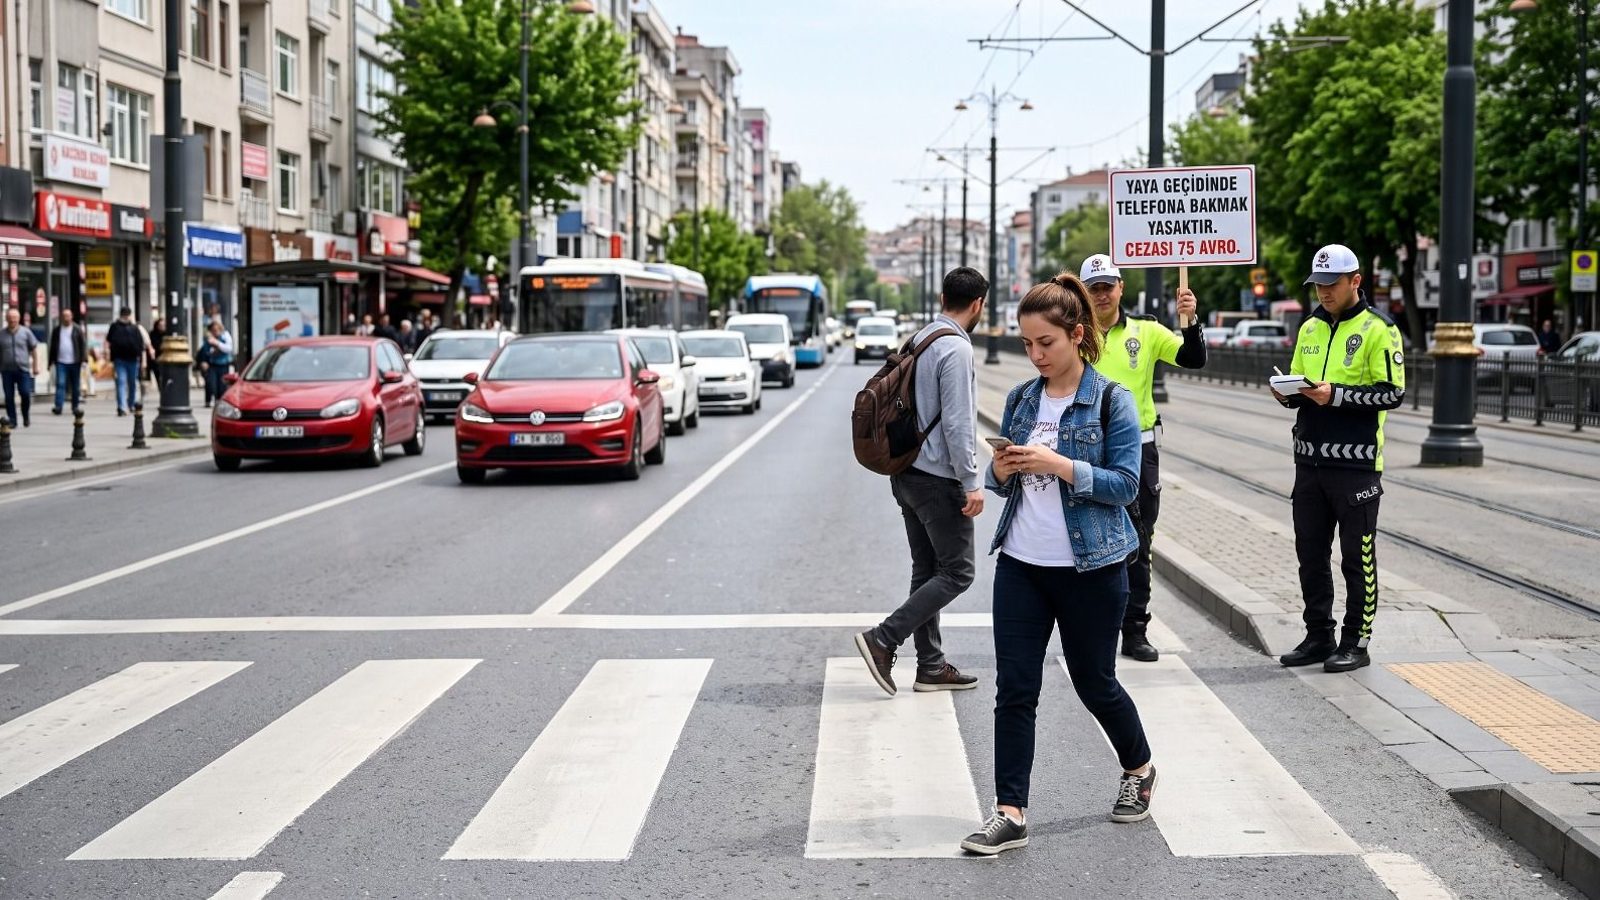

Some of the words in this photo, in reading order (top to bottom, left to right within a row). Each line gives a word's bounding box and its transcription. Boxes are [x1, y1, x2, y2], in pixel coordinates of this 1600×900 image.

[1126, 179, 1159, 194] YAYA
[1163, 173, 1237, 196] GEÇİDİNDE
[1116, 199, 1185, 215] TELEFONA
[1190, 197, 1248, 213] BAKMAK
[1148, 219, 1218, 235] YASAKTIR.
[1125, 241, 1173, 257] CEZASI
[1178, 241, 1195, 255] 75
[1199, 239, 1241, 255] AVRO.
